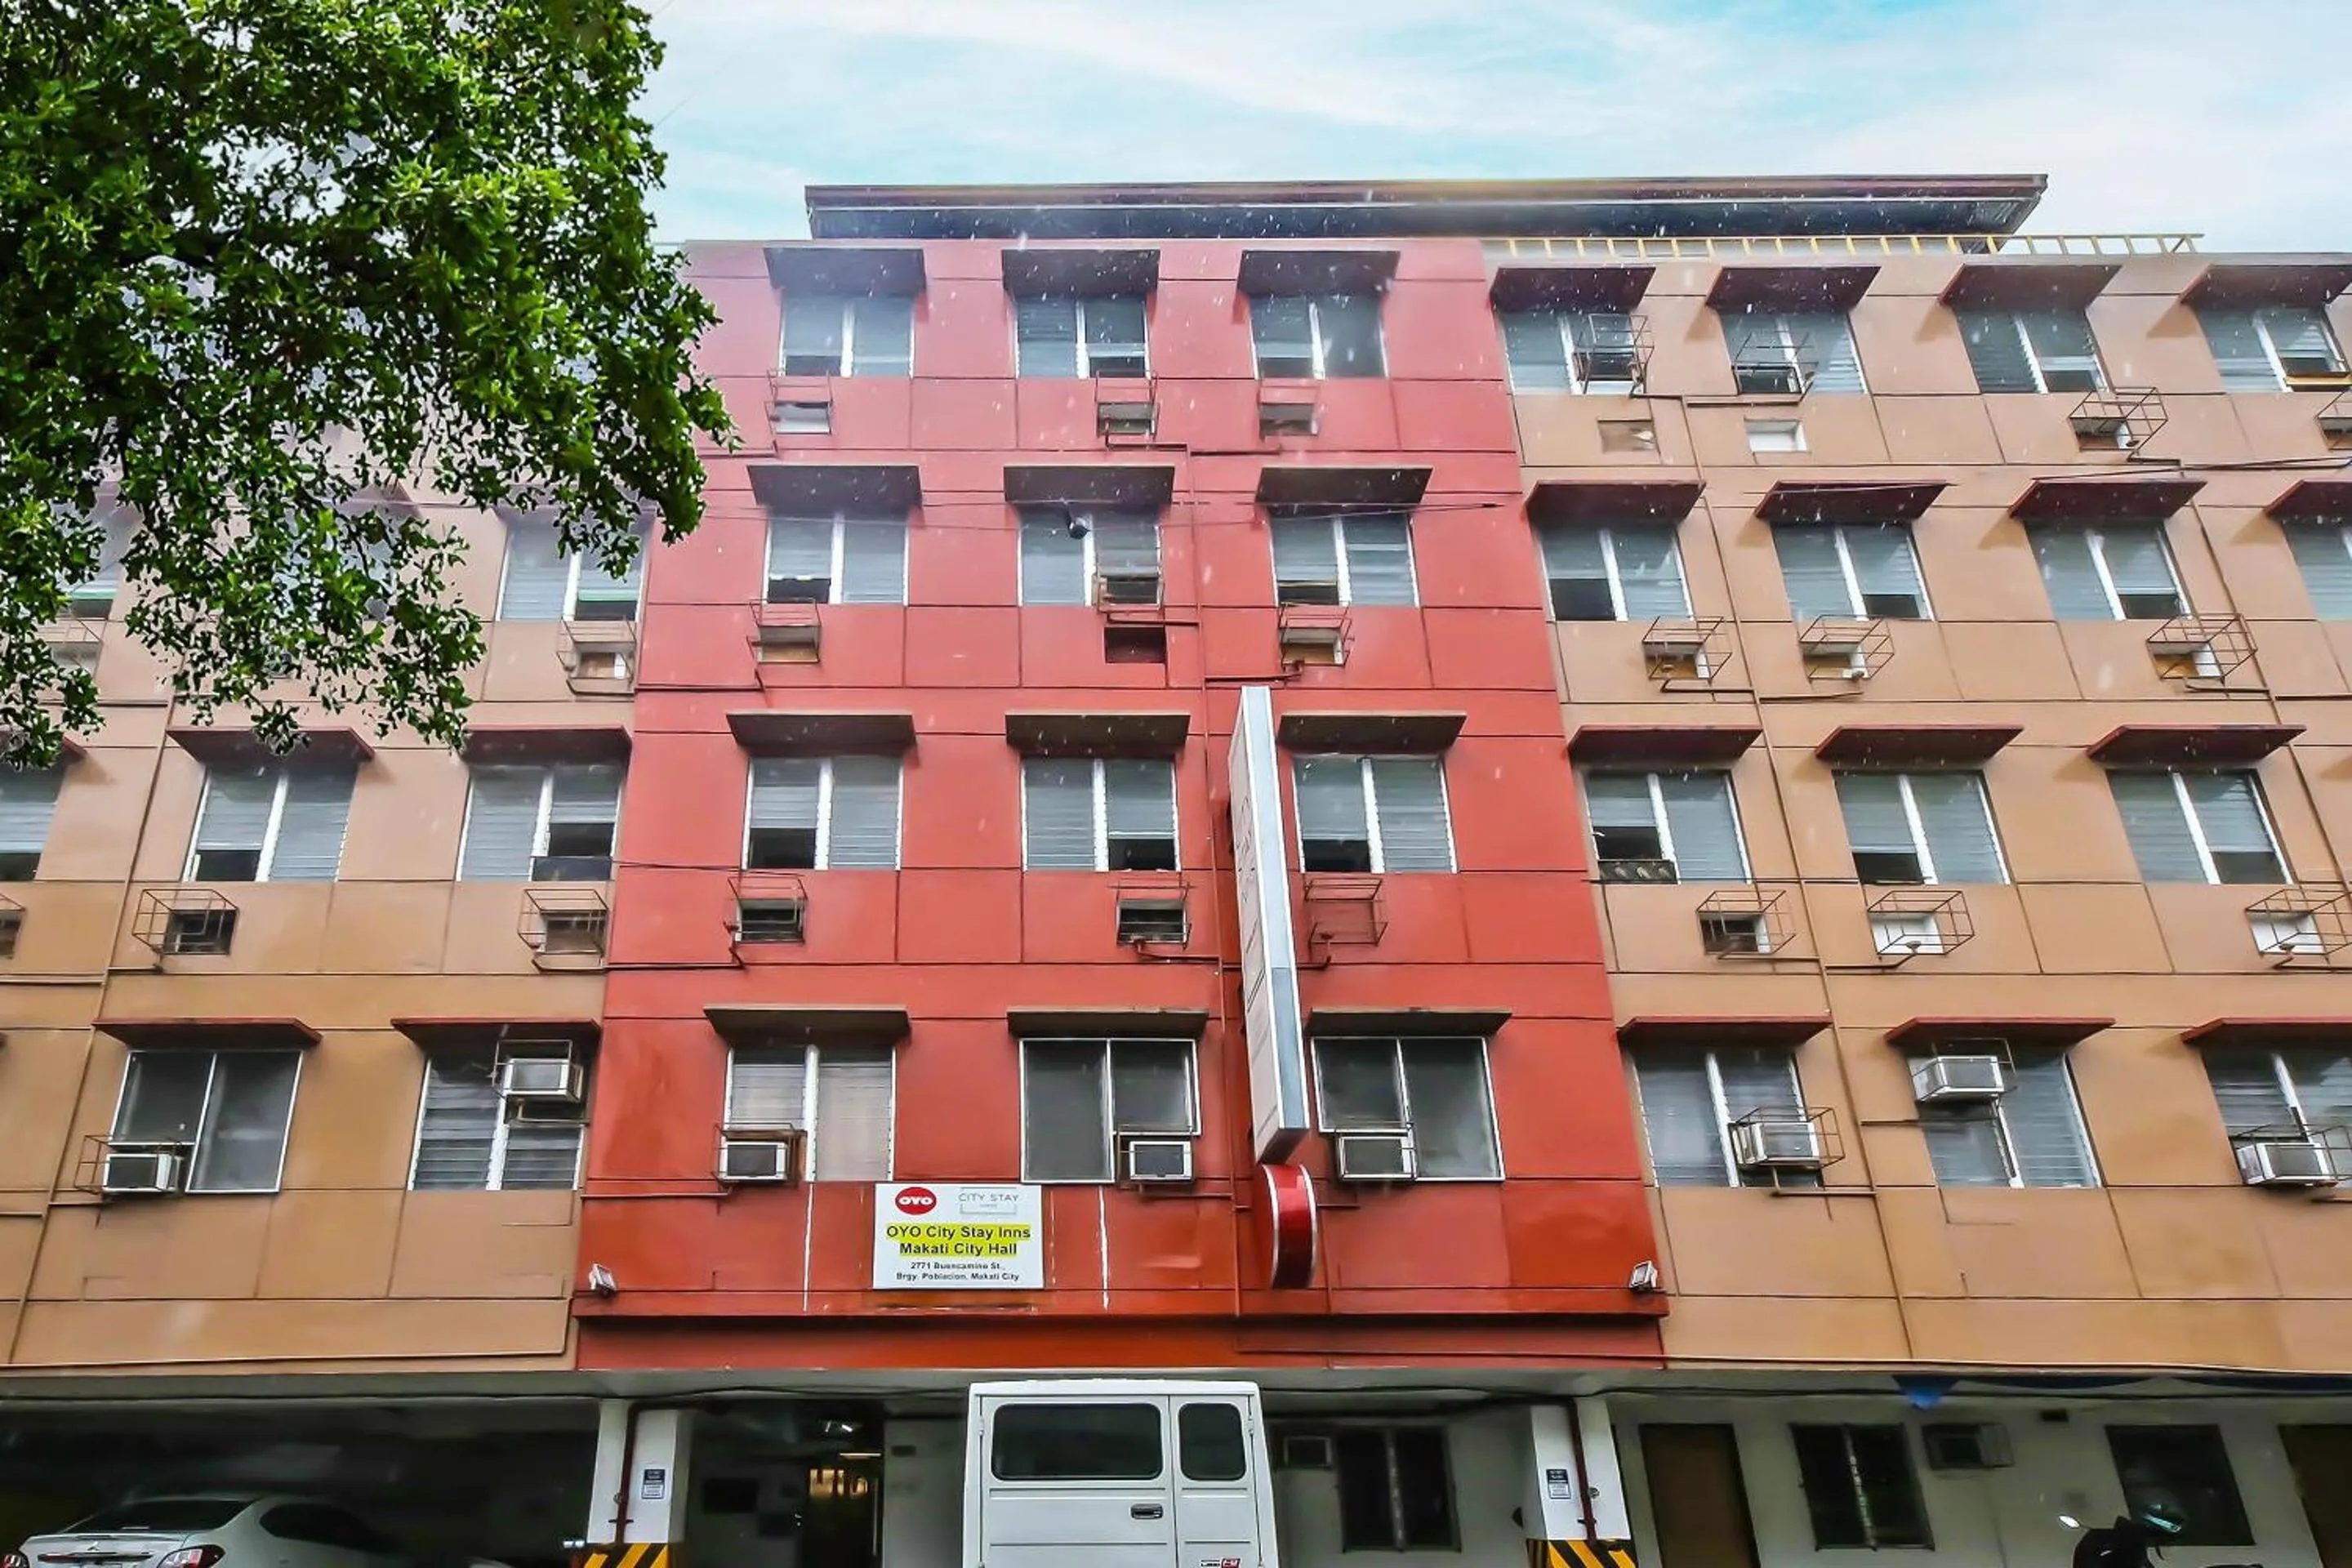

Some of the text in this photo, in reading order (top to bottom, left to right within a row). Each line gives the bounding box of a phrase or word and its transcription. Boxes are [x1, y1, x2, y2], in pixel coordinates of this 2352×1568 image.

[899, 1195, 933, 1205] OYO
[958, 1193, 1019, 1202] CITY STAY
[887, 1226, 1031, 1240] OYO City Stay Inns
[900, 1243, 1017, 1257] Makati City Hall
[1002, 1272, 1019, 1281] City
